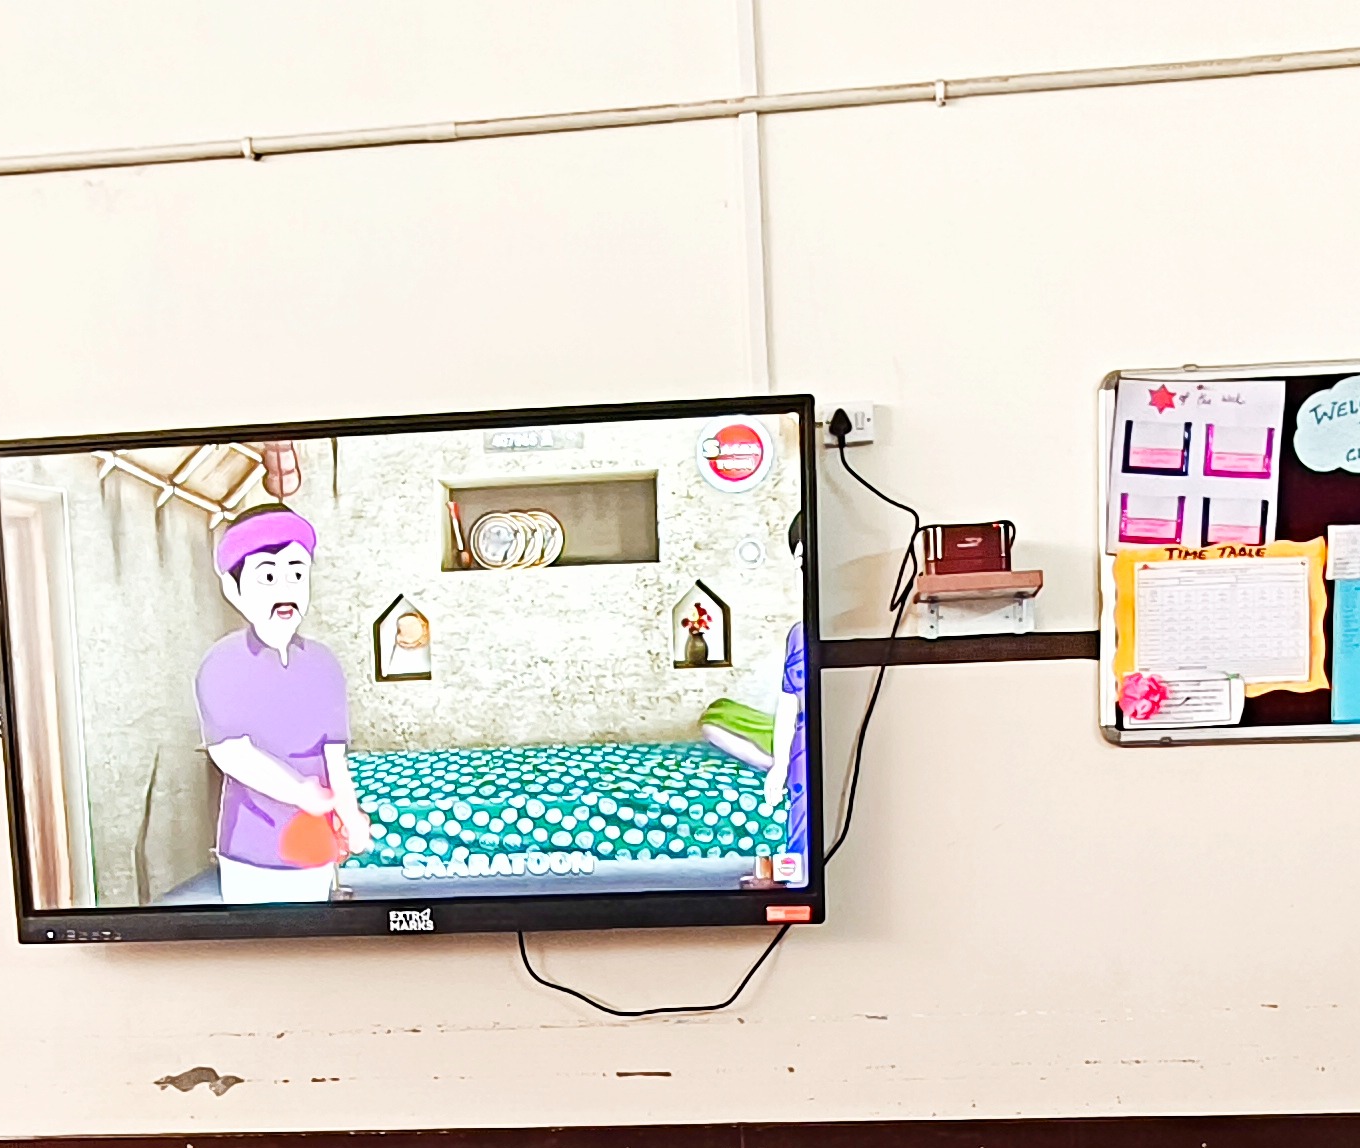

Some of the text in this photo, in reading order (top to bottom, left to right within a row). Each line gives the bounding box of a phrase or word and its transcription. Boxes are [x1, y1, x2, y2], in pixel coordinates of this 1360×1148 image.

[1164, 546, 1267, 560] TIME TABLE
[389, 919, 434, 931] MARKS
